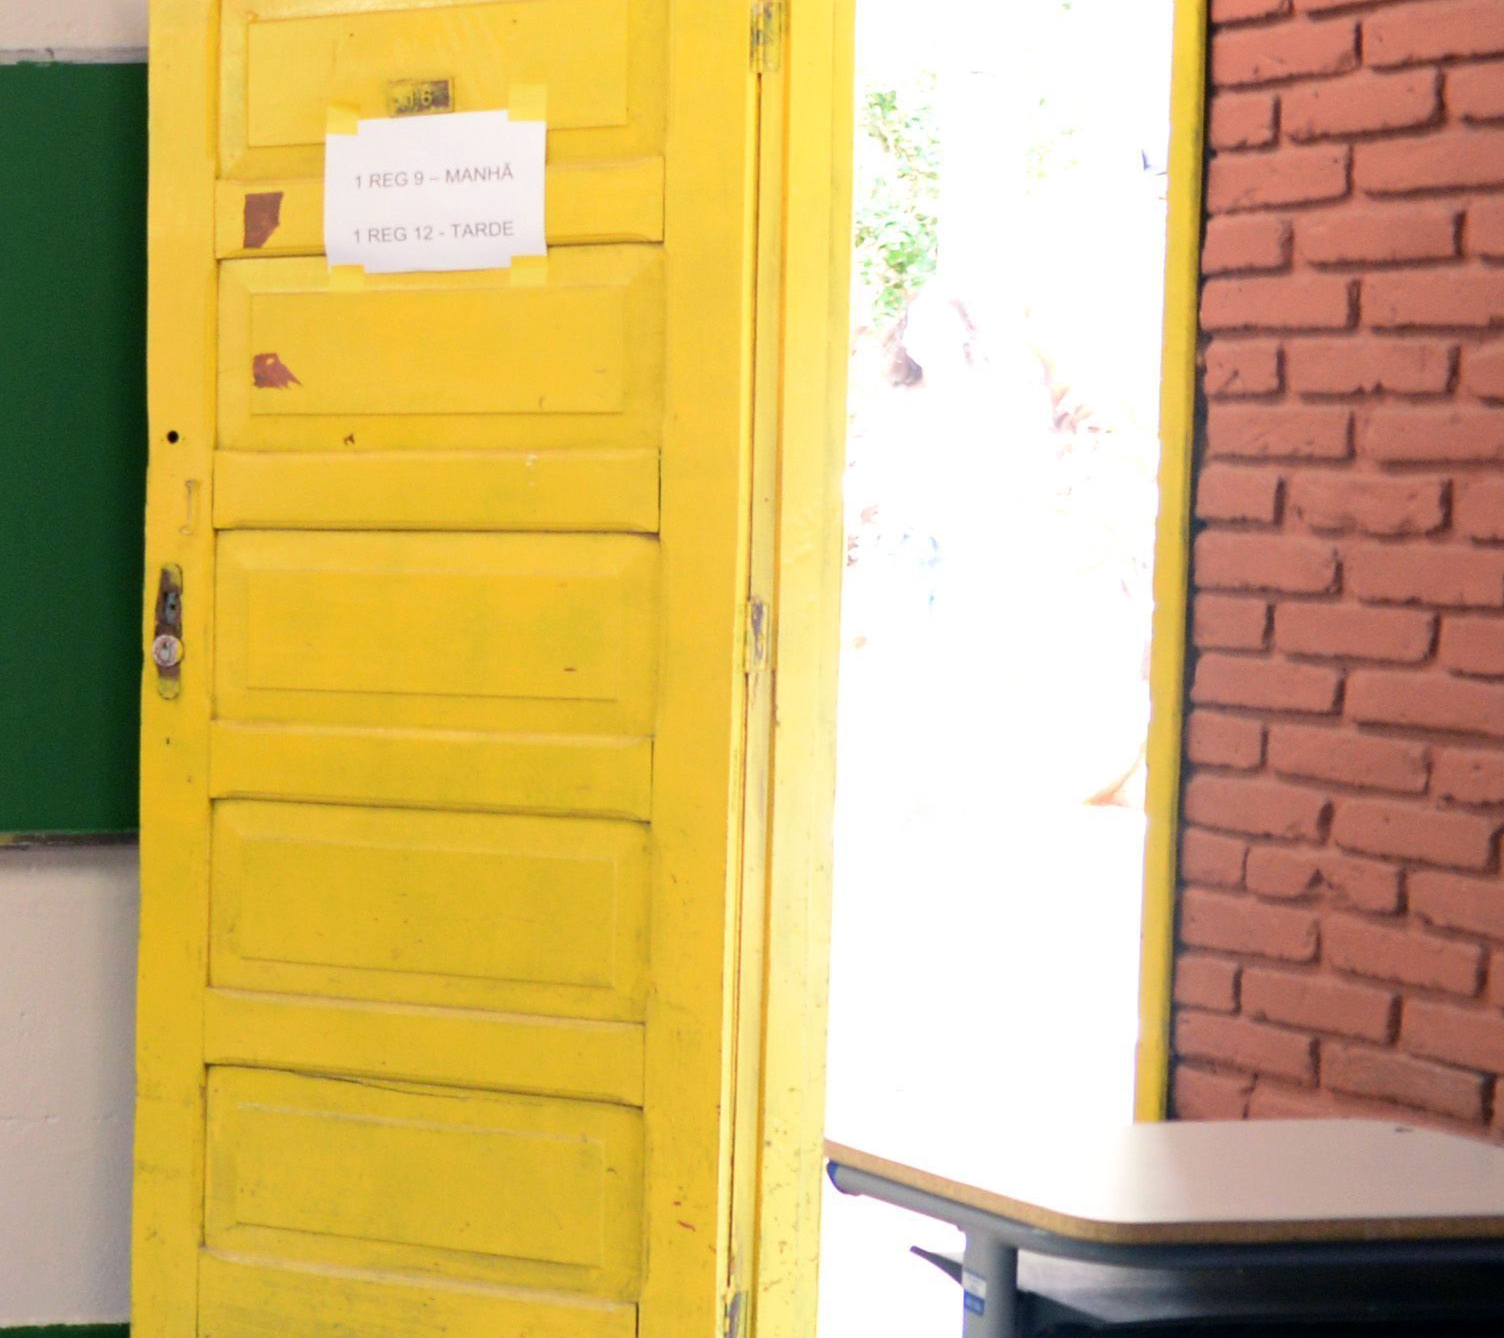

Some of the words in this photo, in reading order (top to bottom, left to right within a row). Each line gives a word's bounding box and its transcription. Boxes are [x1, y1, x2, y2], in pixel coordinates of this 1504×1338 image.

[355, 175, 362, 189] 1
[369, 173, 408, 188] REG
[414, 171, 424, 186] 9
[445, 163, 514, 184] MANHÃ
[353, 229, 361, 244] 1
[368, 226, 407, 242] REG
[415, 224, 433, 241] 12
[451, 221, 514, 239] TARDE
